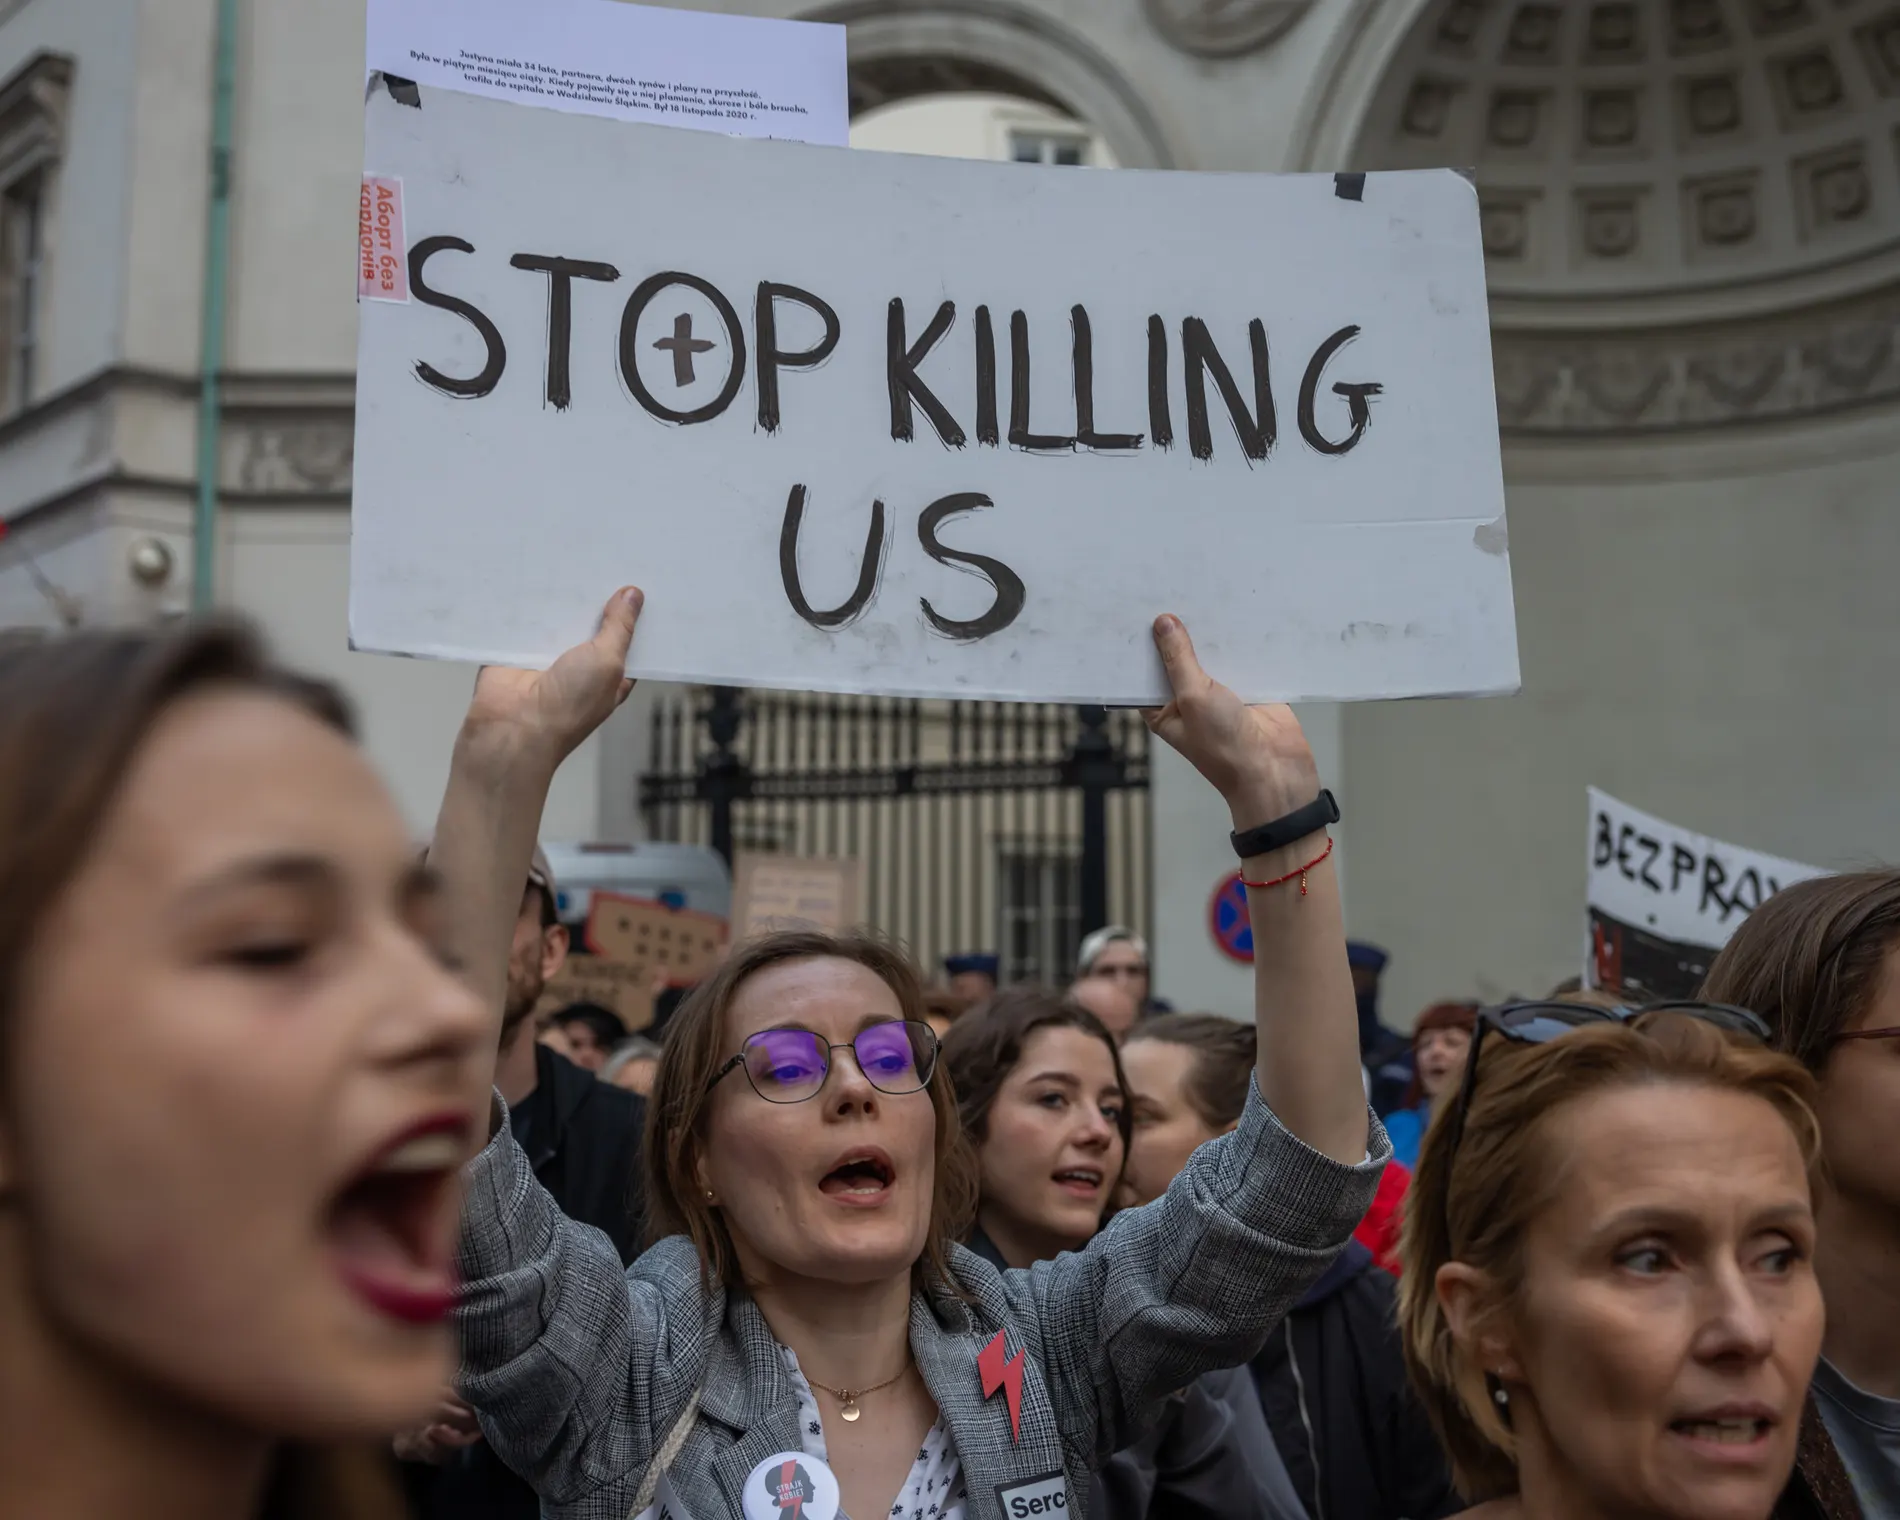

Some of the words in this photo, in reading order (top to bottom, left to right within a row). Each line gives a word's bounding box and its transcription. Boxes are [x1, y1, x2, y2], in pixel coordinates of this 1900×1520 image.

[410, 49, 430, 62] Była
[432, 56, 441, 64] w
[442, 58, 475, 71] piątym
[477, 64, 517, 79] miesiącu
[548, 76, 574, 90] Kiedy
[576, 82, 615, 96] pojawiły
[617, 87, 630, 97] się
[640, 90, 657, 101] niej
[658, 91, 706, 106] plamienia,
[708, 97, 741, 109] skurcze
[749, 100, 768, 111] bóle
[770, 102, 808, 115] brzucha,
[460, 49, 494, 63] Justyna
[496, 57, 522, 69] miała
[538, 63, 559, 76] lata,
[561, 69, 603, 82] partnera,
[606, 74, 636, 86] dwóch
[638, 80, 666, 90] synów
[673, 82, 698, 94] plany
[700, 87, 712, 95] na
[464, 73, 493, 86] trafiła
[494, 78, 507, 88] do
[509, 82, 544, 94] szpitala
[556, 88, 613, 104] Wodzisławiu
[615, 96, 652, 110] Śląskim.
[654, 102, 668, 113] Był
[670, 104, 680, 113] 18
[681, 105, 724, 117] listopada
[725, 110, 748, 120] 2020
[750, 113, 757, 121] r.
[374, 185, 395, 250] Аборт
[380, 254, 398, 291] без
[408, 235, 841, 437] STOP
[886, 296, 1384, 467] KILLING
[779, 483, 1026, 642] US
[776, 1479, 803, 1494] STRAJK
[779, 1488, 804, 1502] KOBIET
[1010, 1491, 1068, 1519] Serc
